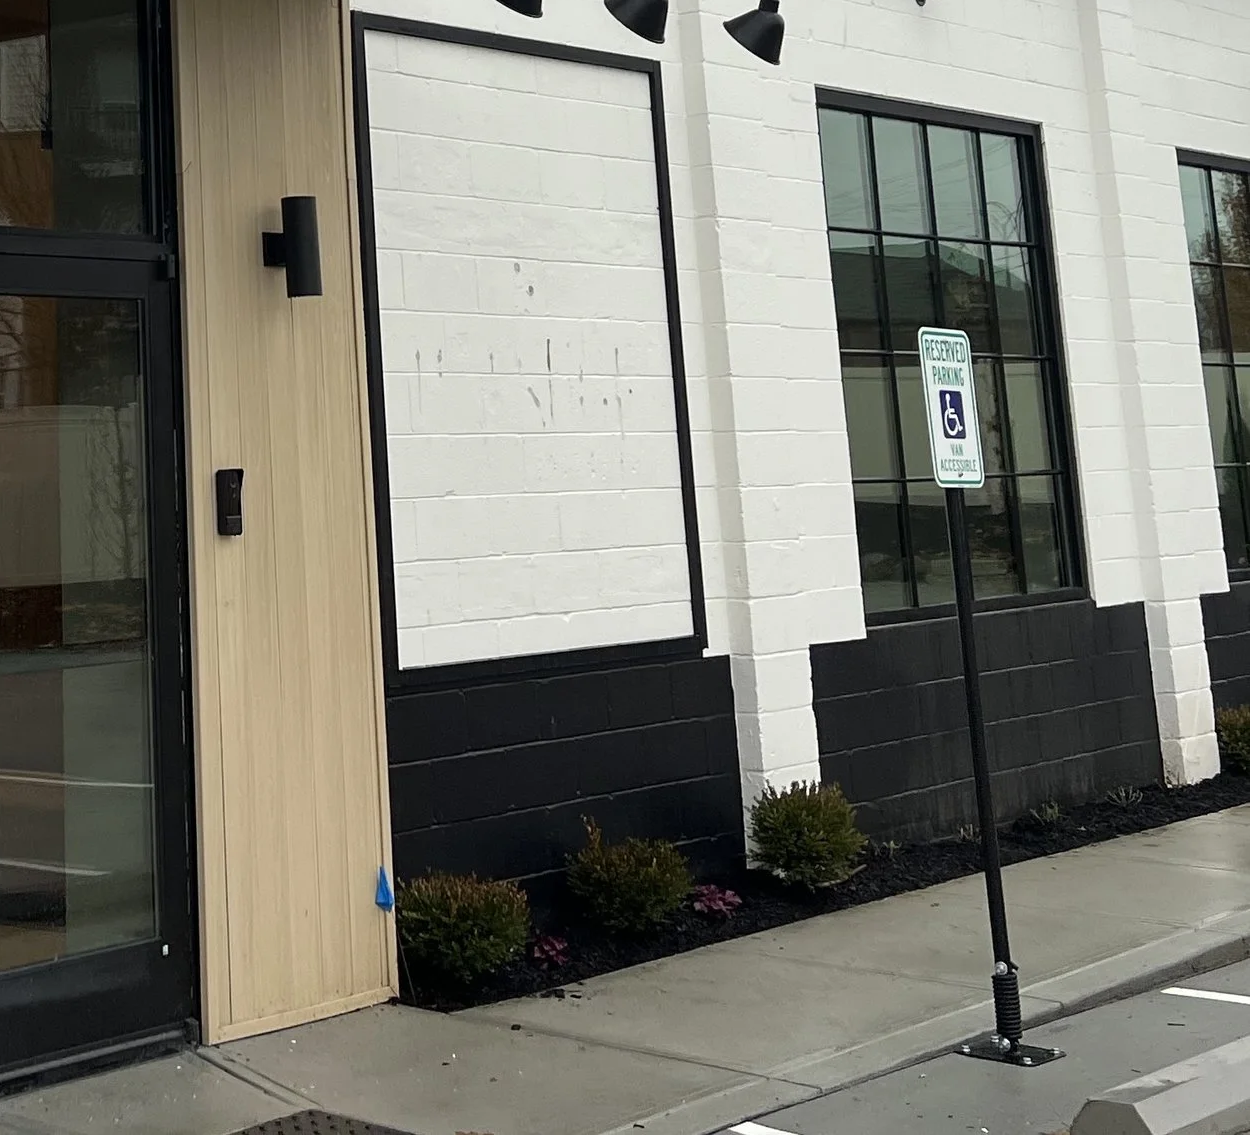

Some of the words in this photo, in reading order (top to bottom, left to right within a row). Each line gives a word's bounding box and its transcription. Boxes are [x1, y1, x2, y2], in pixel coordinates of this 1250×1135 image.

[924, 338, 966, 363] RESERVED
[932, 365, 964, 386] PARKING
[951, 443, 964, 456] VAN
[940, 458, 978, 472] ACCESSIBLE
